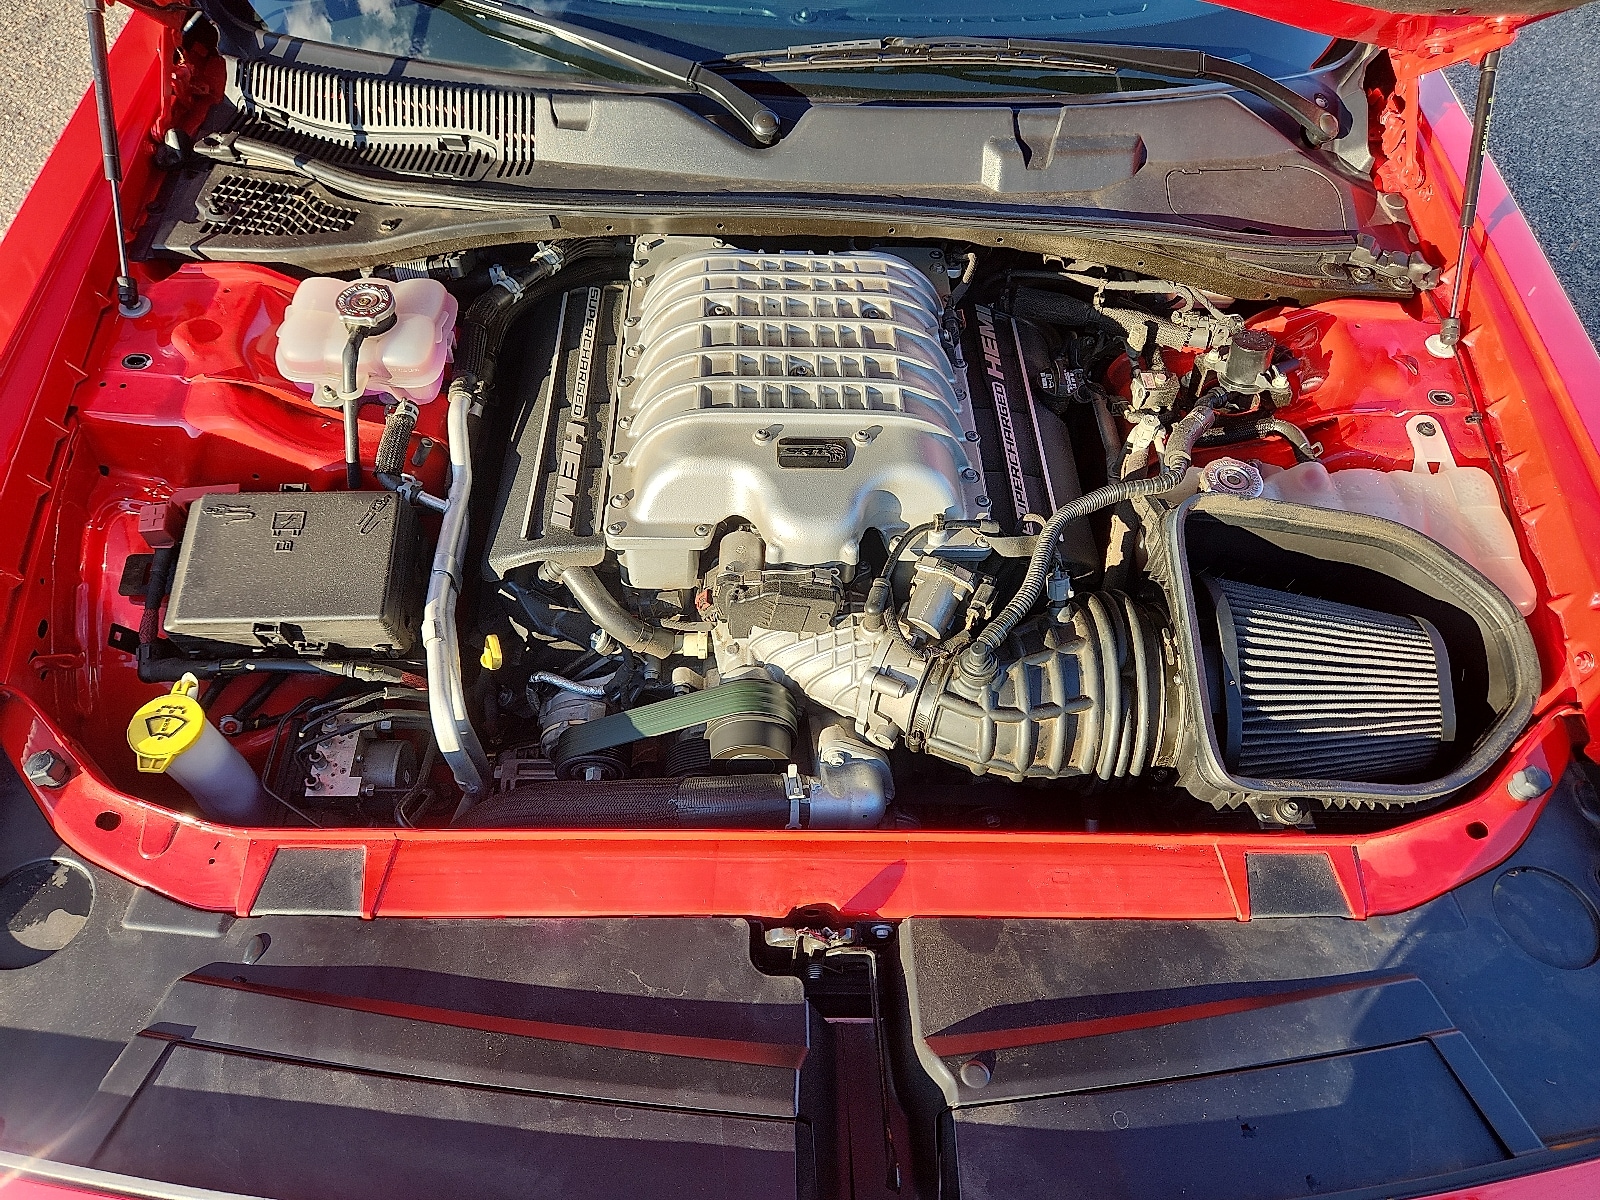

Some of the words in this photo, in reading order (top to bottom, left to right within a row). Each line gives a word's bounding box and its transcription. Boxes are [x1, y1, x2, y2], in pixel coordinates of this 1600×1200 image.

[571, 286, 600, 418] SUPERCHARGED
[975, 303, 1005, 380] HEMI
[551, 421, 585, 530] HEMI
